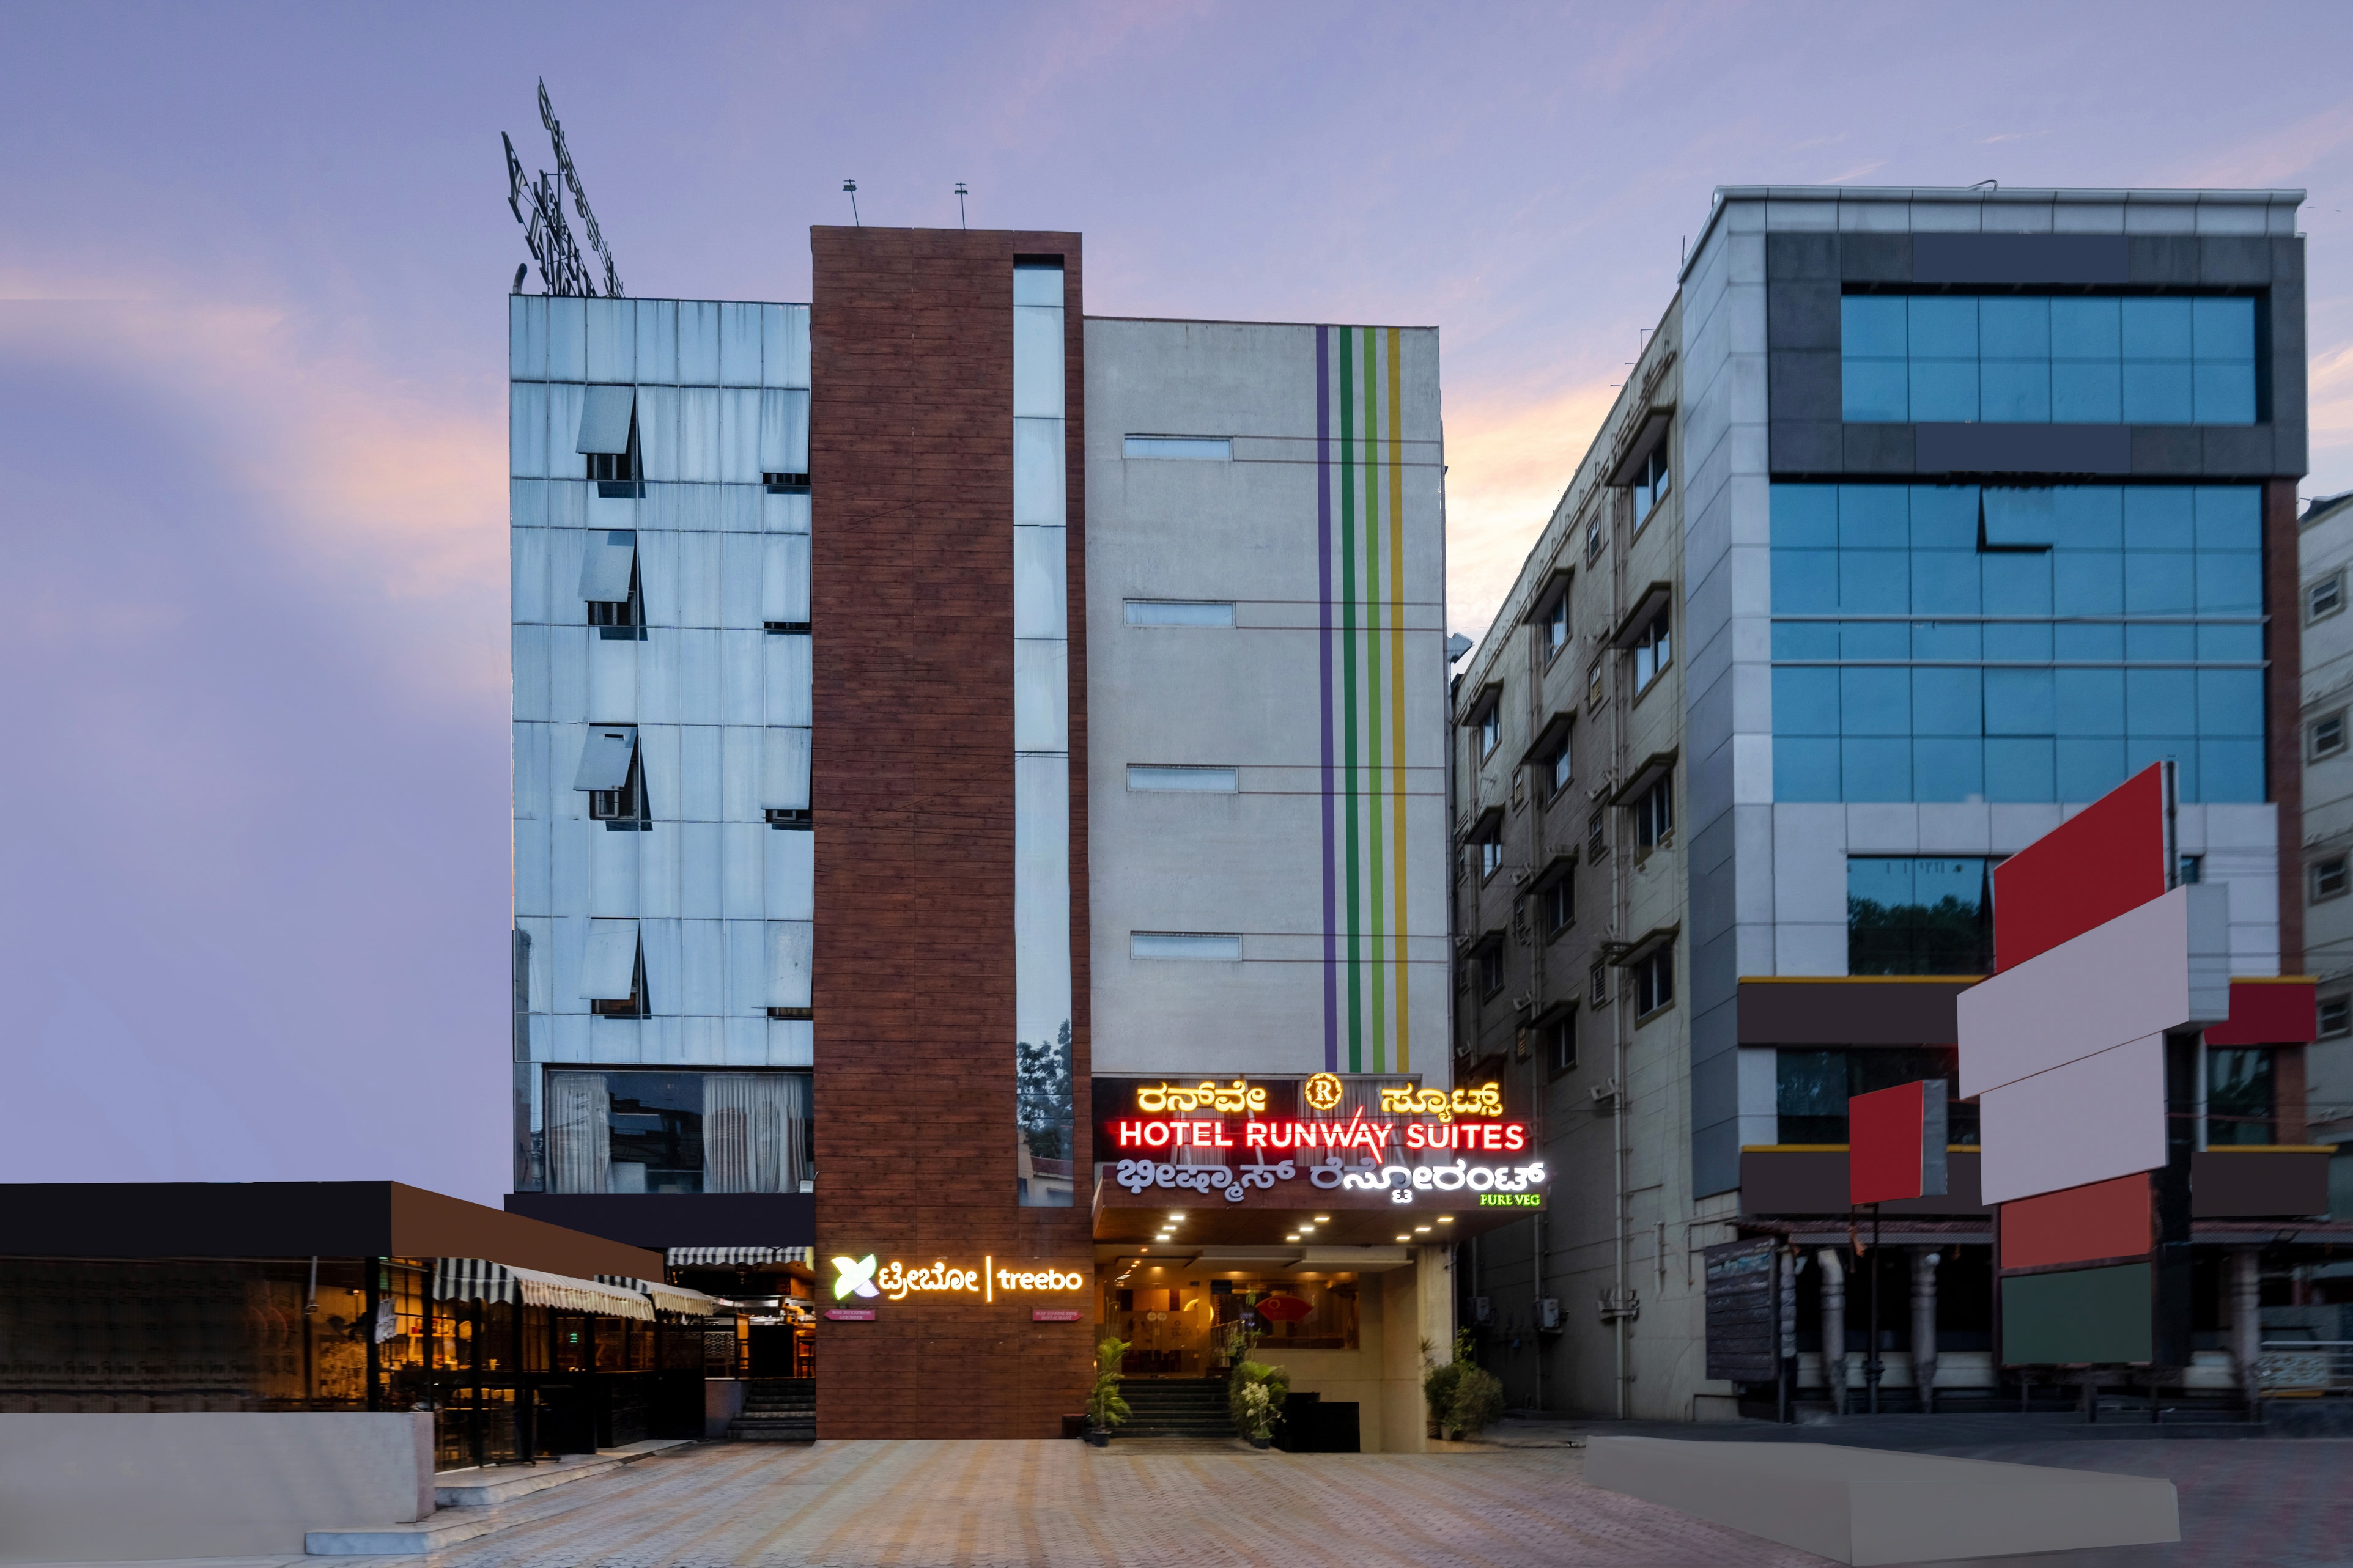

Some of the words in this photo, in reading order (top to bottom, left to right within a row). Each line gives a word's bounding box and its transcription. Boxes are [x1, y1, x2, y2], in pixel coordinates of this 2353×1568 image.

[1120, 1121, 1233, 1147] HOTEL
[1246, 1105, 1394, 1164] RUNWAY
[1406, 1123, 1526, 1150] SUITES
[1480, 1194, 1513, 1206] PURE
[1513, 1194, 1541, 1207] VEG
[997, 1268, 1083, 1290] treebo
